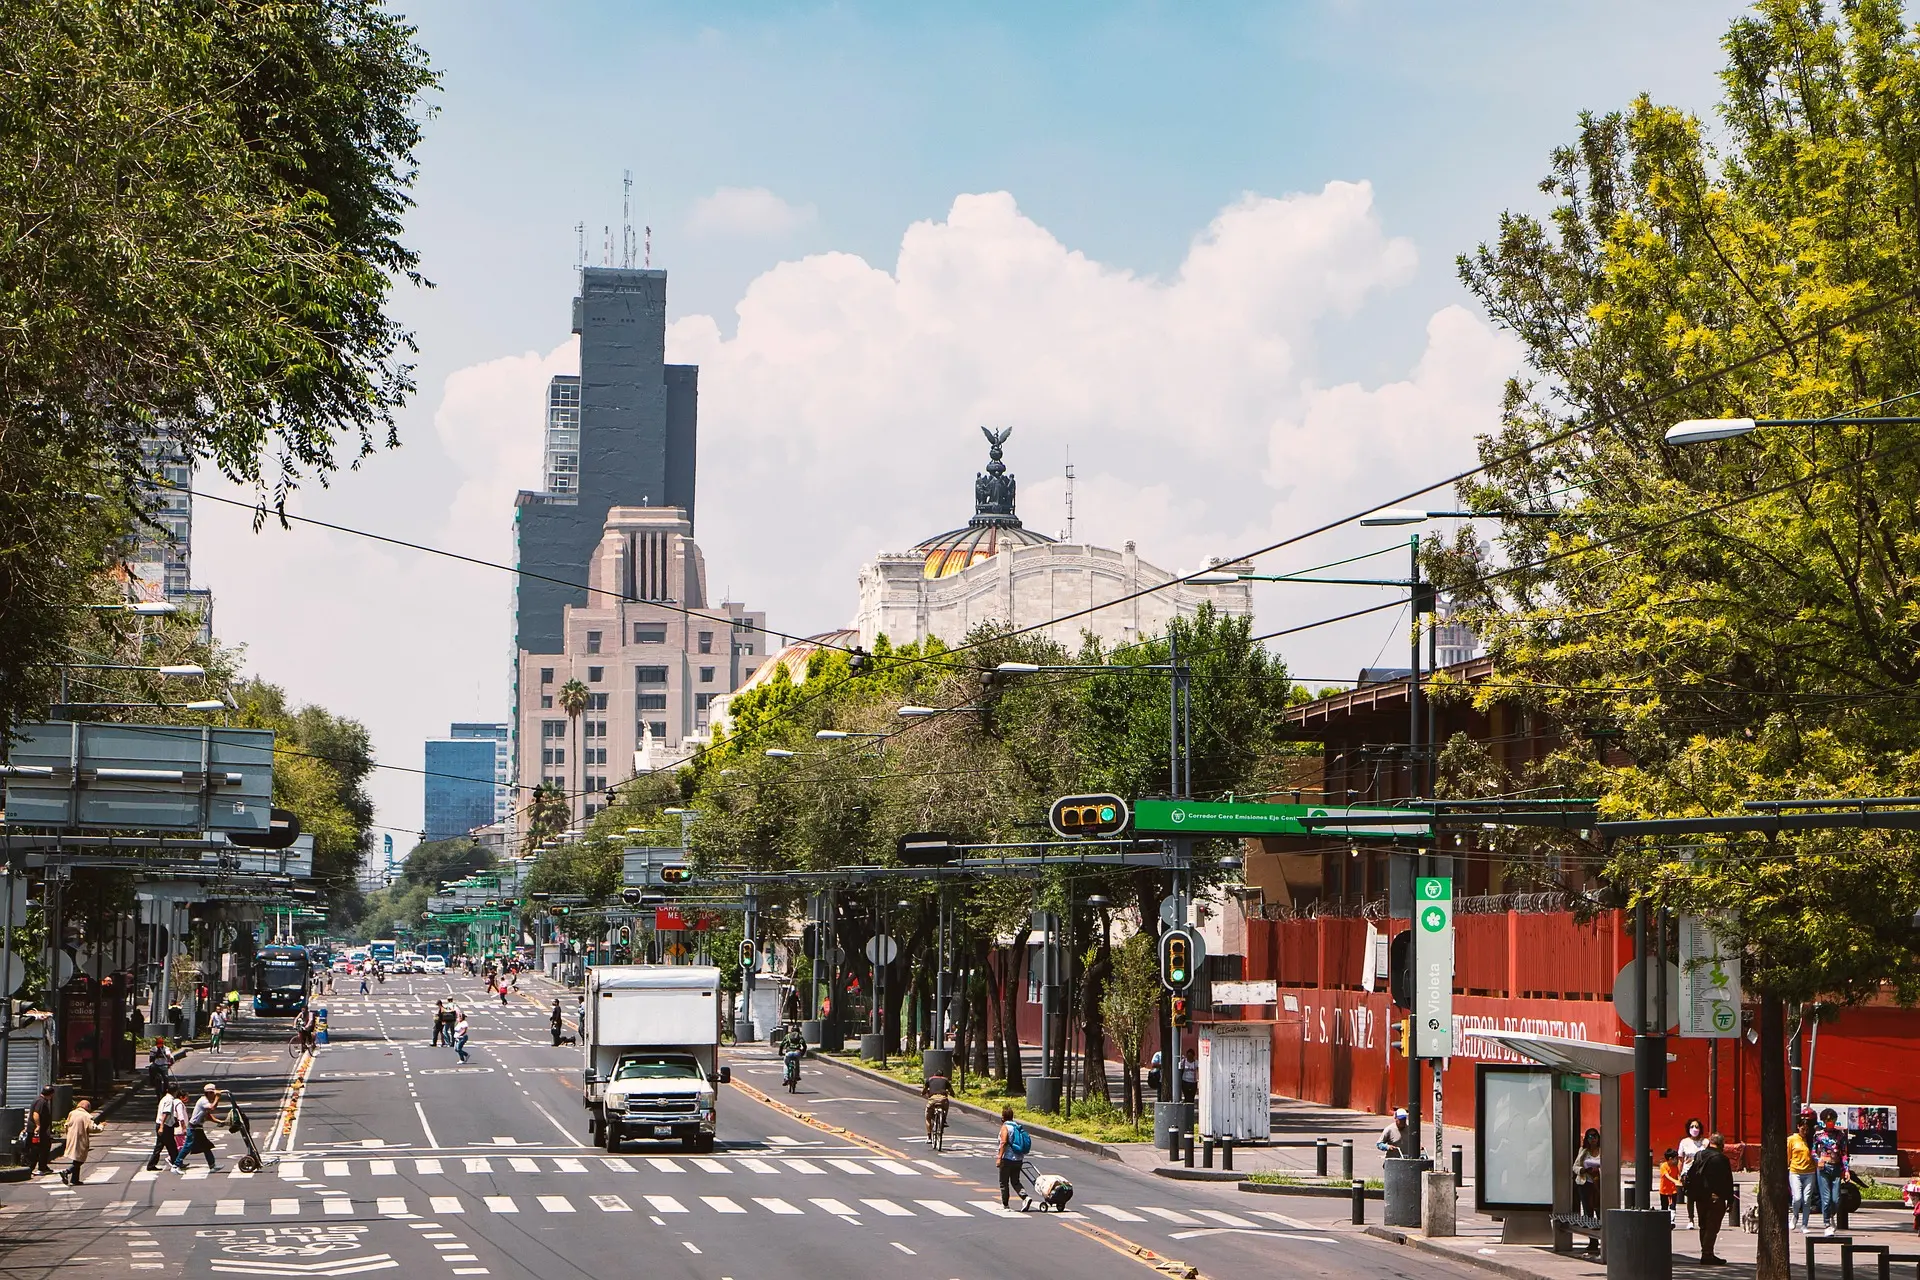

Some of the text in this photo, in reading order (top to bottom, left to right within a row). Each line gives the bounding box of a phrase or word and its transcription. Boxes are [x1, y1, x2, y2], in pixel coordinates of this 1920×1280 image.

[1428, 963, 1440, 1014] Violeta
[1452, 1014, 1502, 1060] EGIDORA
[1503, 1017, 1518, 1061] DE
[195, 1225, 369, 1237] SOLO
[217, 1233, 359, 1245] BUS
